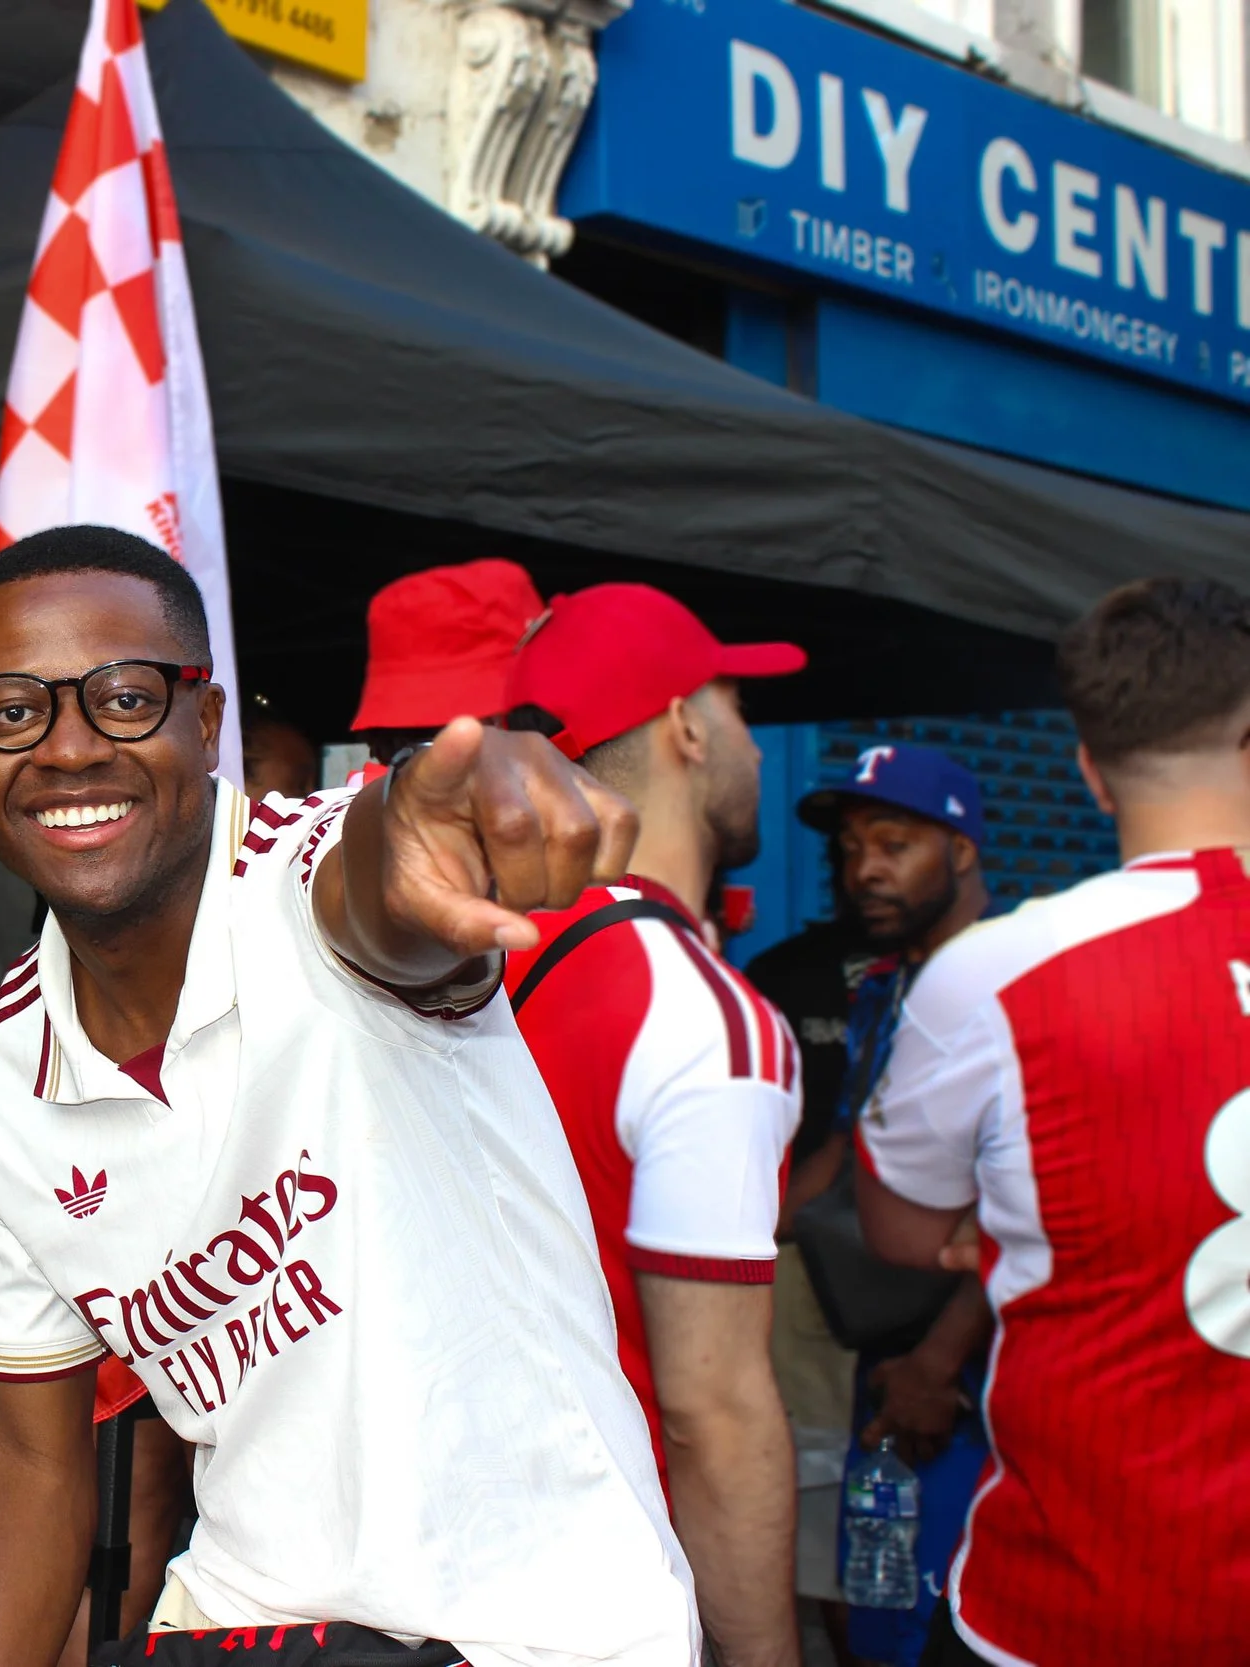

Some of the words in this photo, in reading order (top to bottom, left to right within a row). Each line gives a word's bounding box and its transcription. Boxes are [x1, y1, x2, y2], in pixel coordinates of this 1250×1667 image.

[729, 38, 929, 214] DIY
[979, 135, 1250, 331] CENT
[789, 208, 915, 284] TIMBER
[974, 268, 1178, 364] IRONMONGERY
[854, 744, 896, 784] T
[73, 1149, 338, 1366] Emirates
[158, 1335, 227, 1417] FLY
